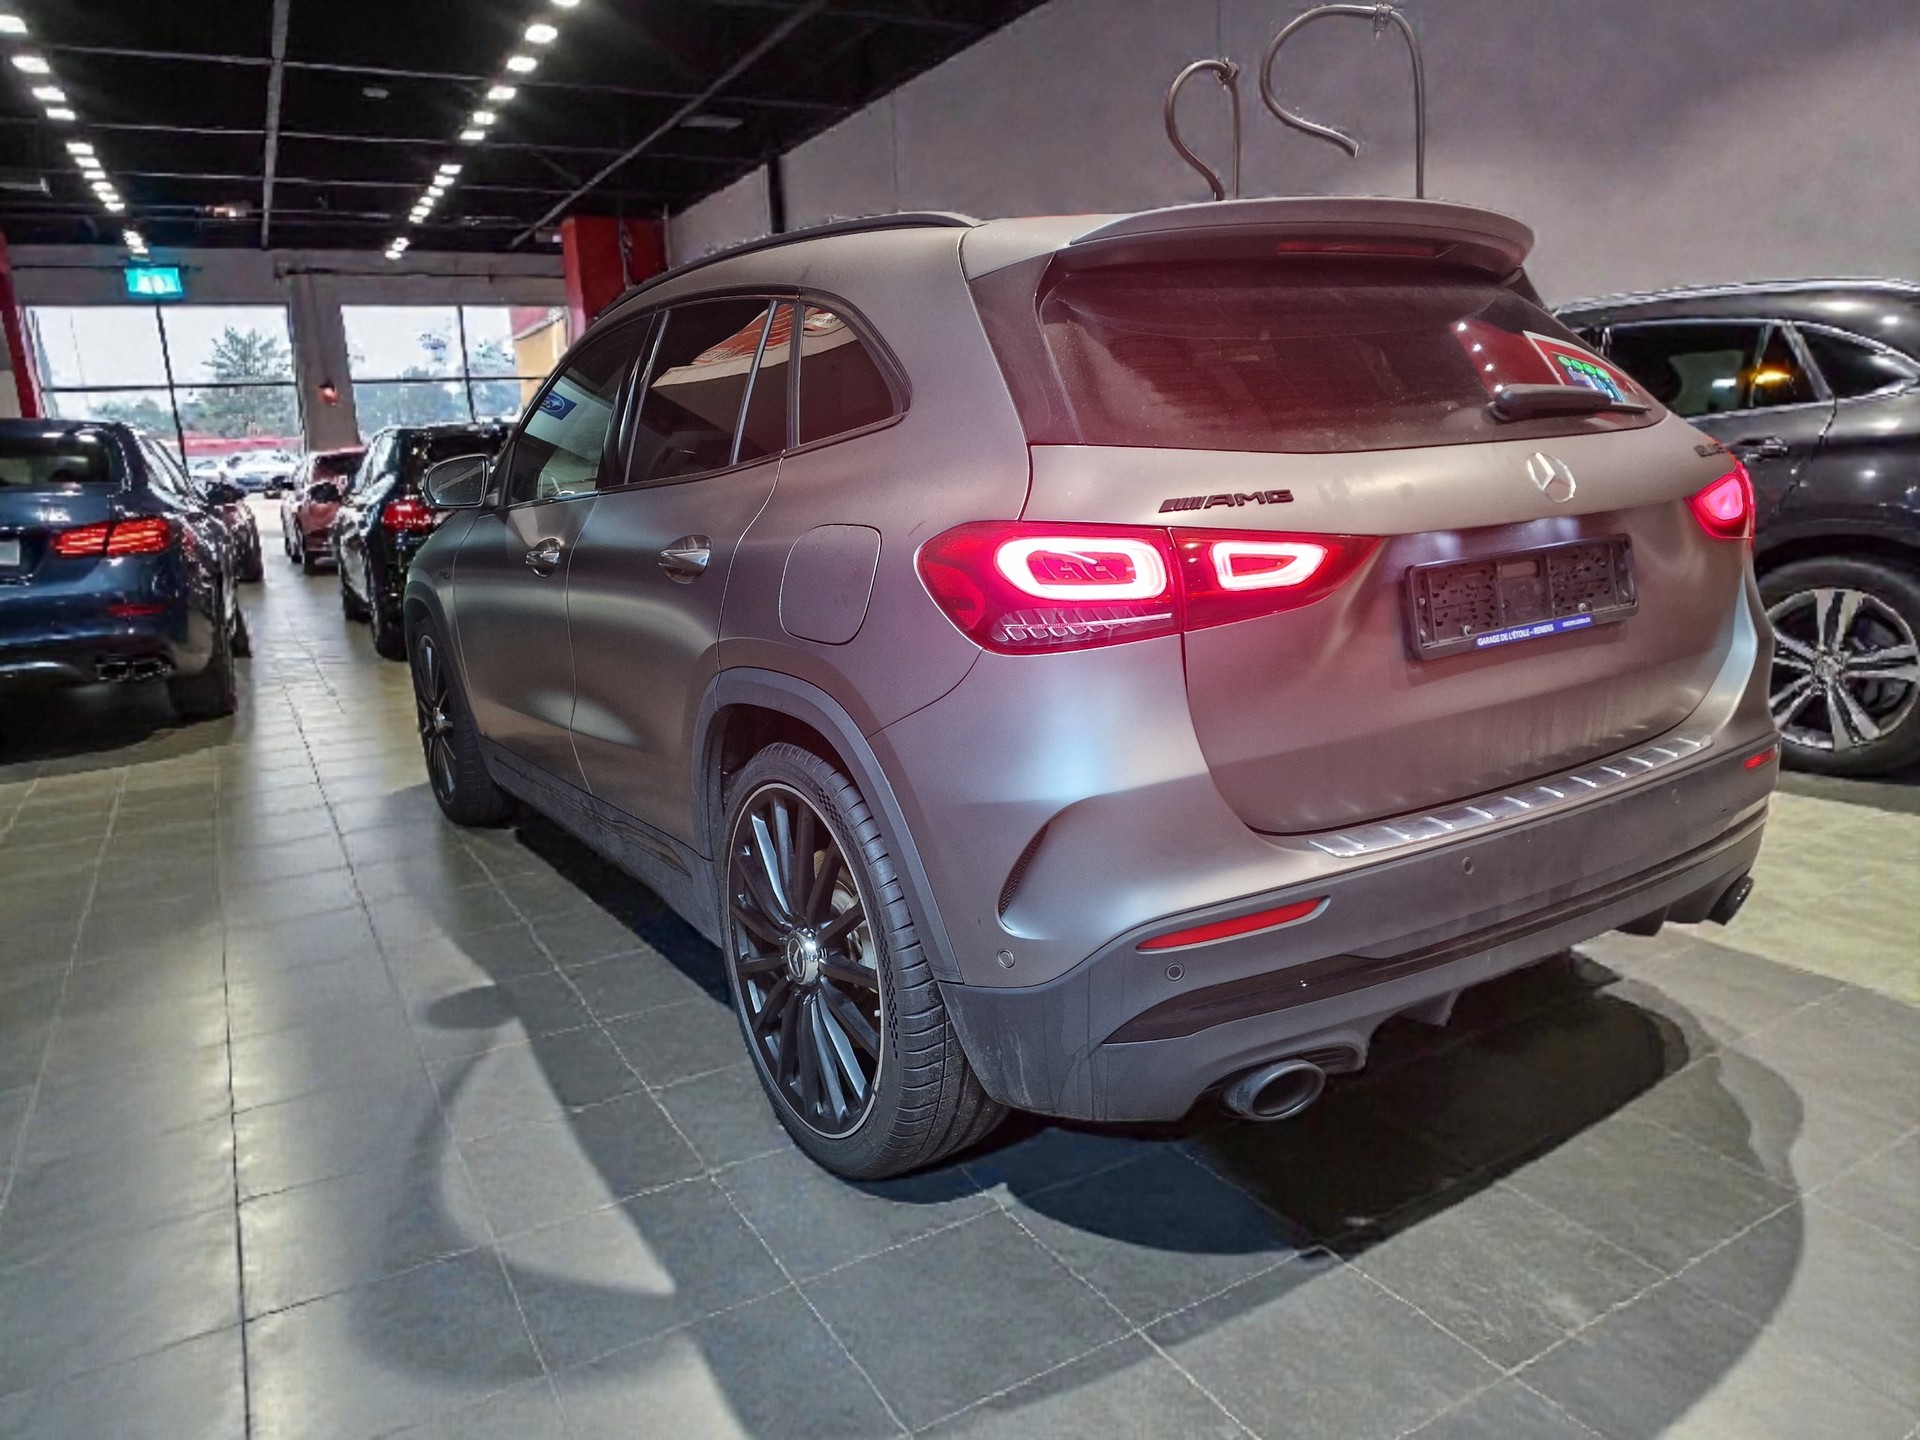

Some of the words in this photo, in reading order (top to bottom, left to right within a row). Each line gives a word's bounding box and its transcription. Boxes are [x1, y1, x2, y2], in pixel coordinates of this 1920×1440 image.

[1203, 489, 1294, 509] AMG
[1477, 635, 1501, 646] GARAGE
[1500, 633, 1509, 642] DE
